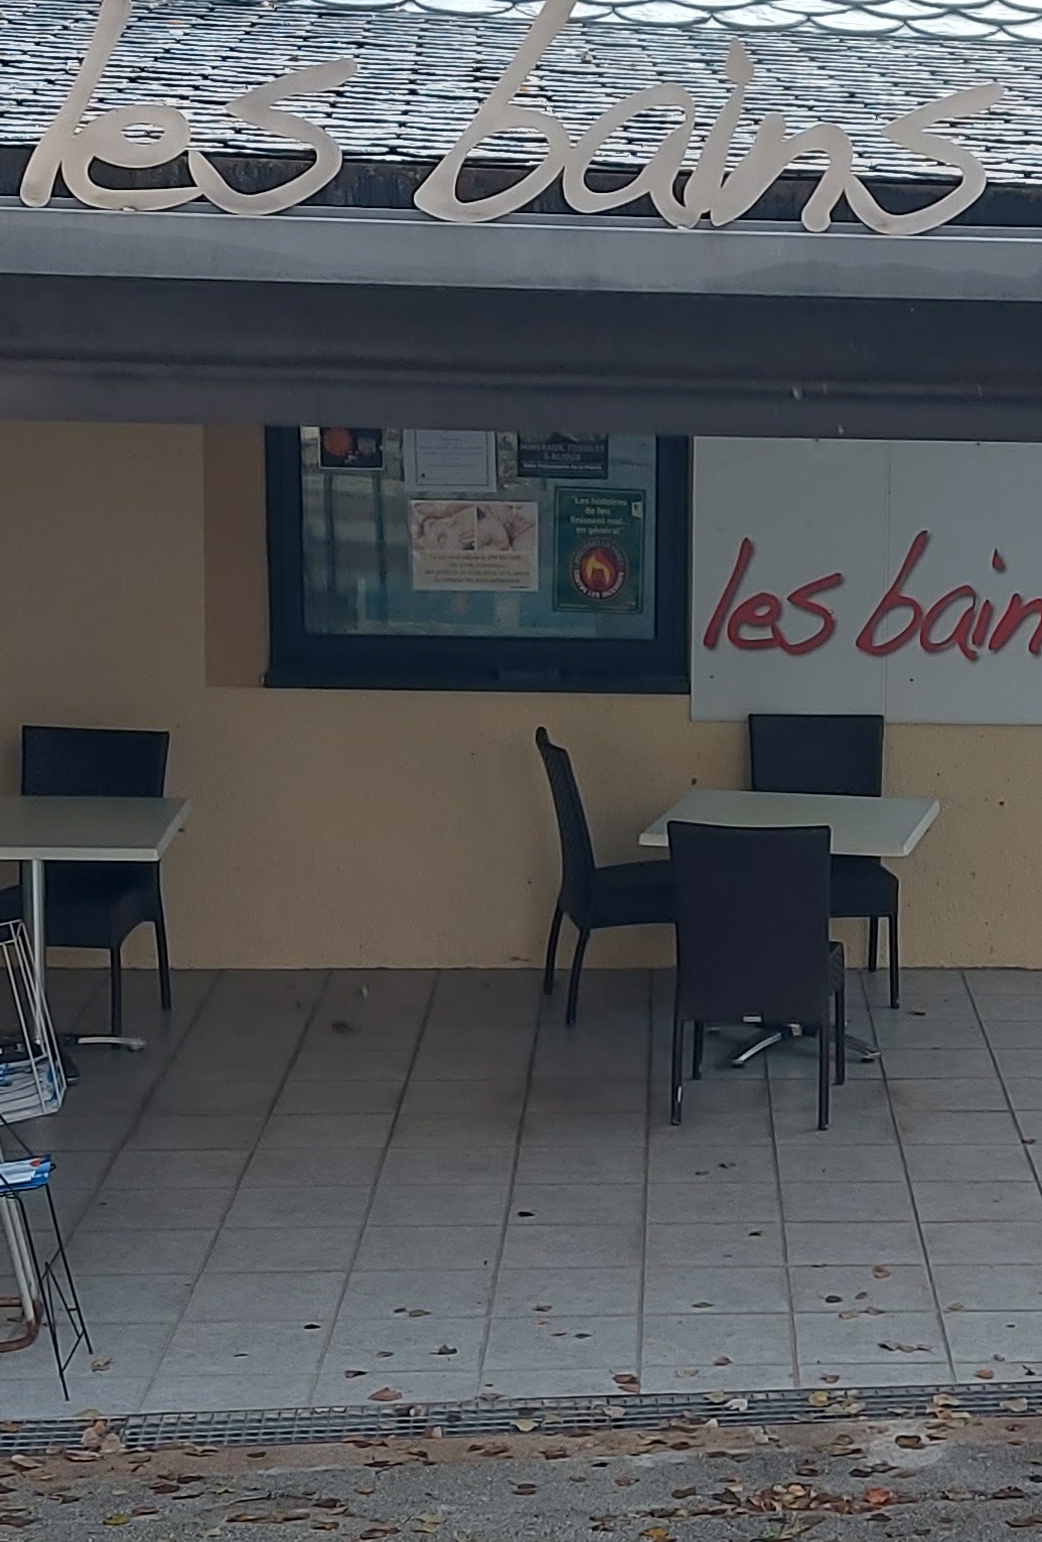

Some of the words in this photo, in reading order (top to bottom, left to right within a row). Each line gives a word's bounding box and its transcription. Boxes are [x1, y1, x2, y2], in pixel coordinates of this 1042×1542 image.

[591, 496, 628, 507] histoires
[584, 507, 595, 515] de
[703, 537, 842, 656] les
